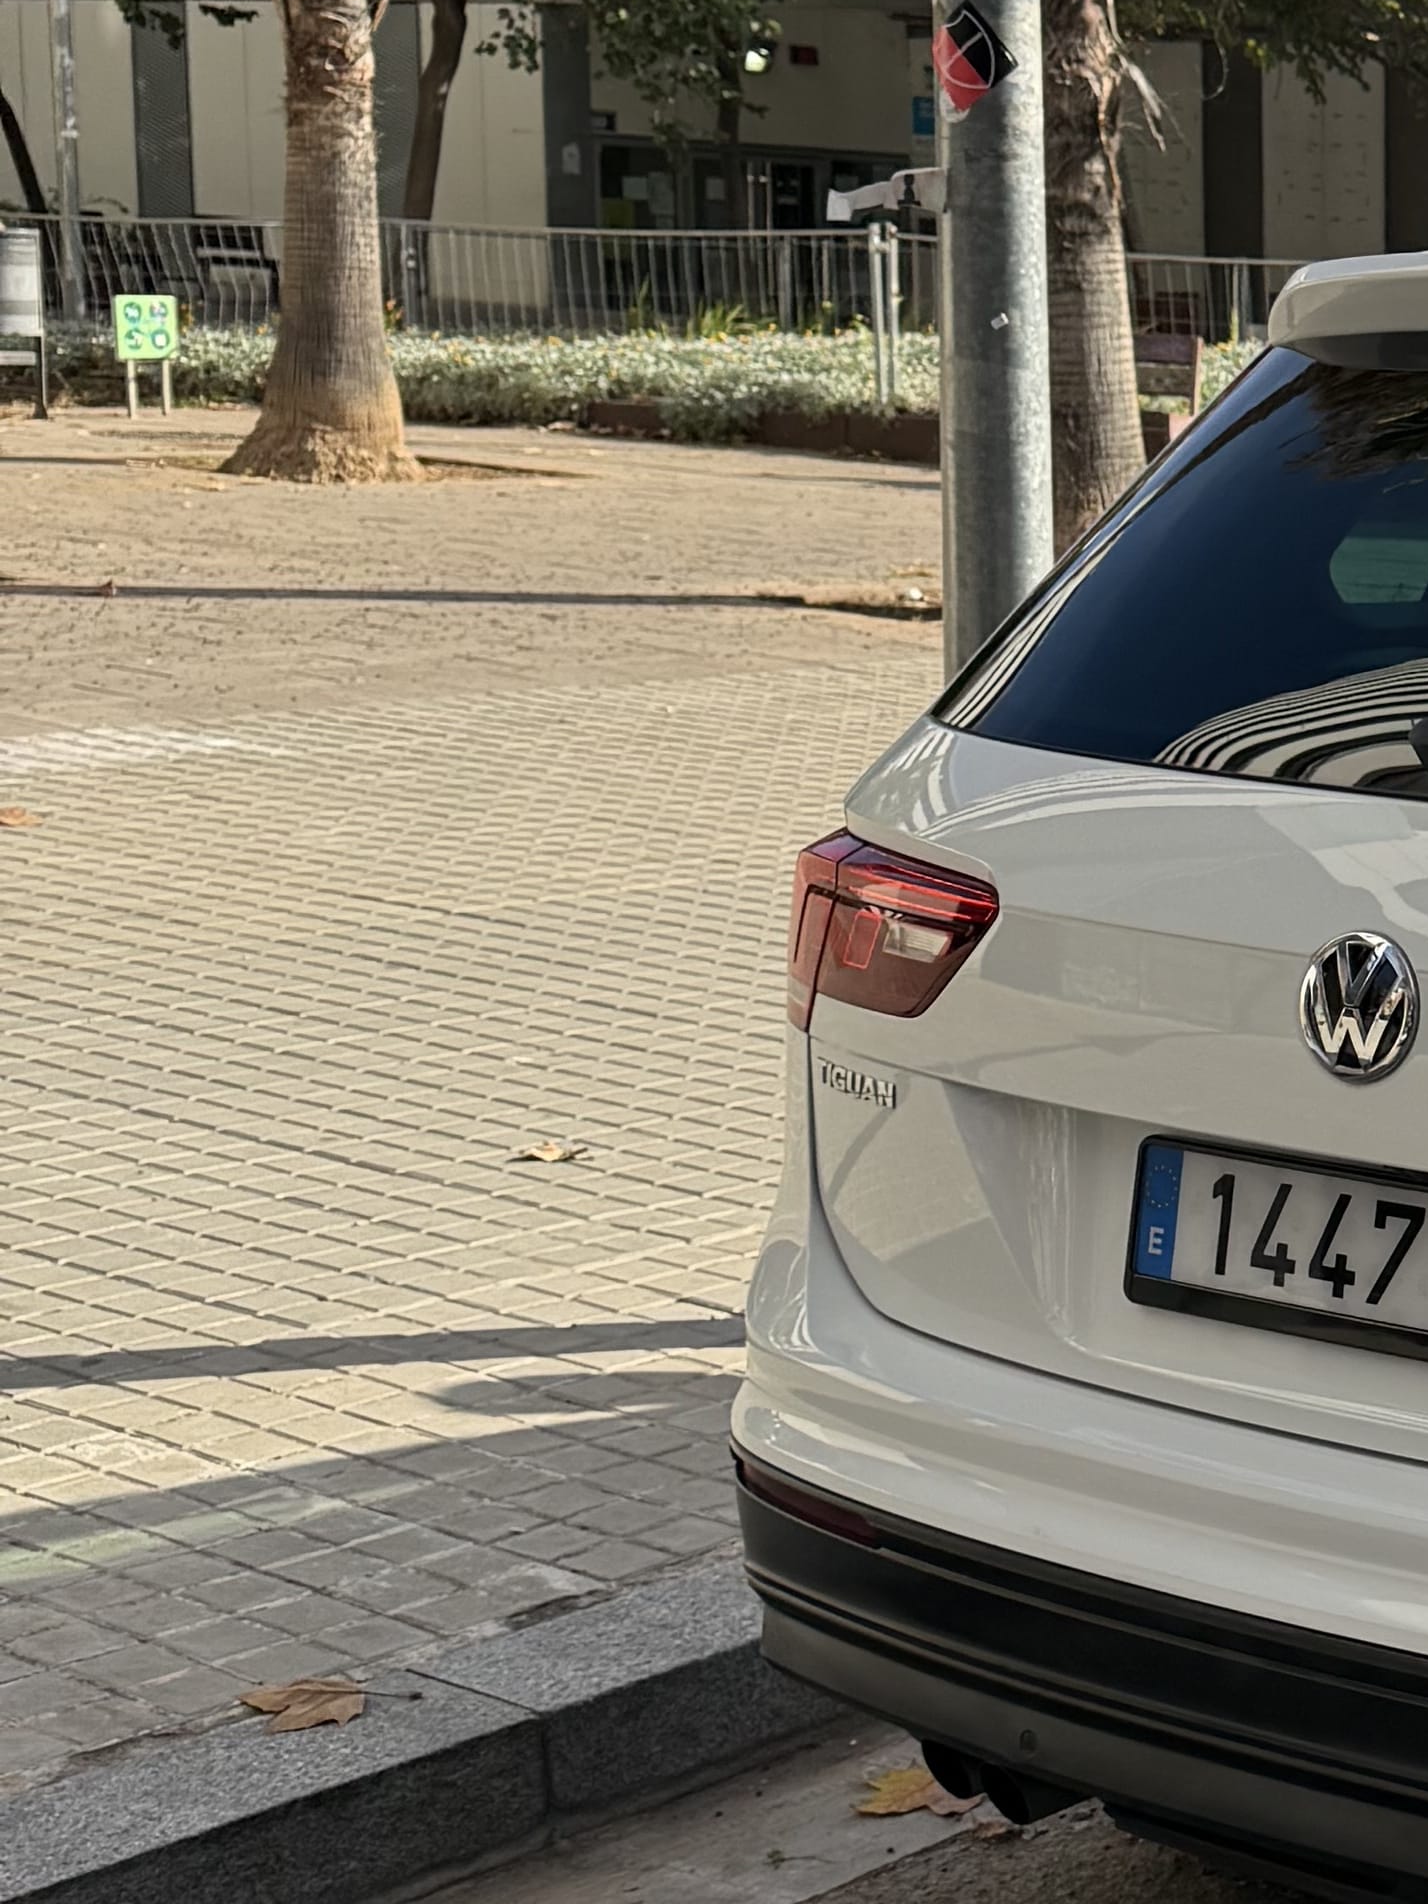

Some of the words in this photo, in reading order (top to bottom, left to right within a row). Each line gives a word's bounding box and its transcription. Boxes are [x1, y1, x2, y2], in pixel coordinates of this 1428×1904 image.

[817, 1057, 897, 1109] TIGUAN
[1148, 1227, 1164, 1256] E
[1212, 1172, 1426, 1306] 1447
